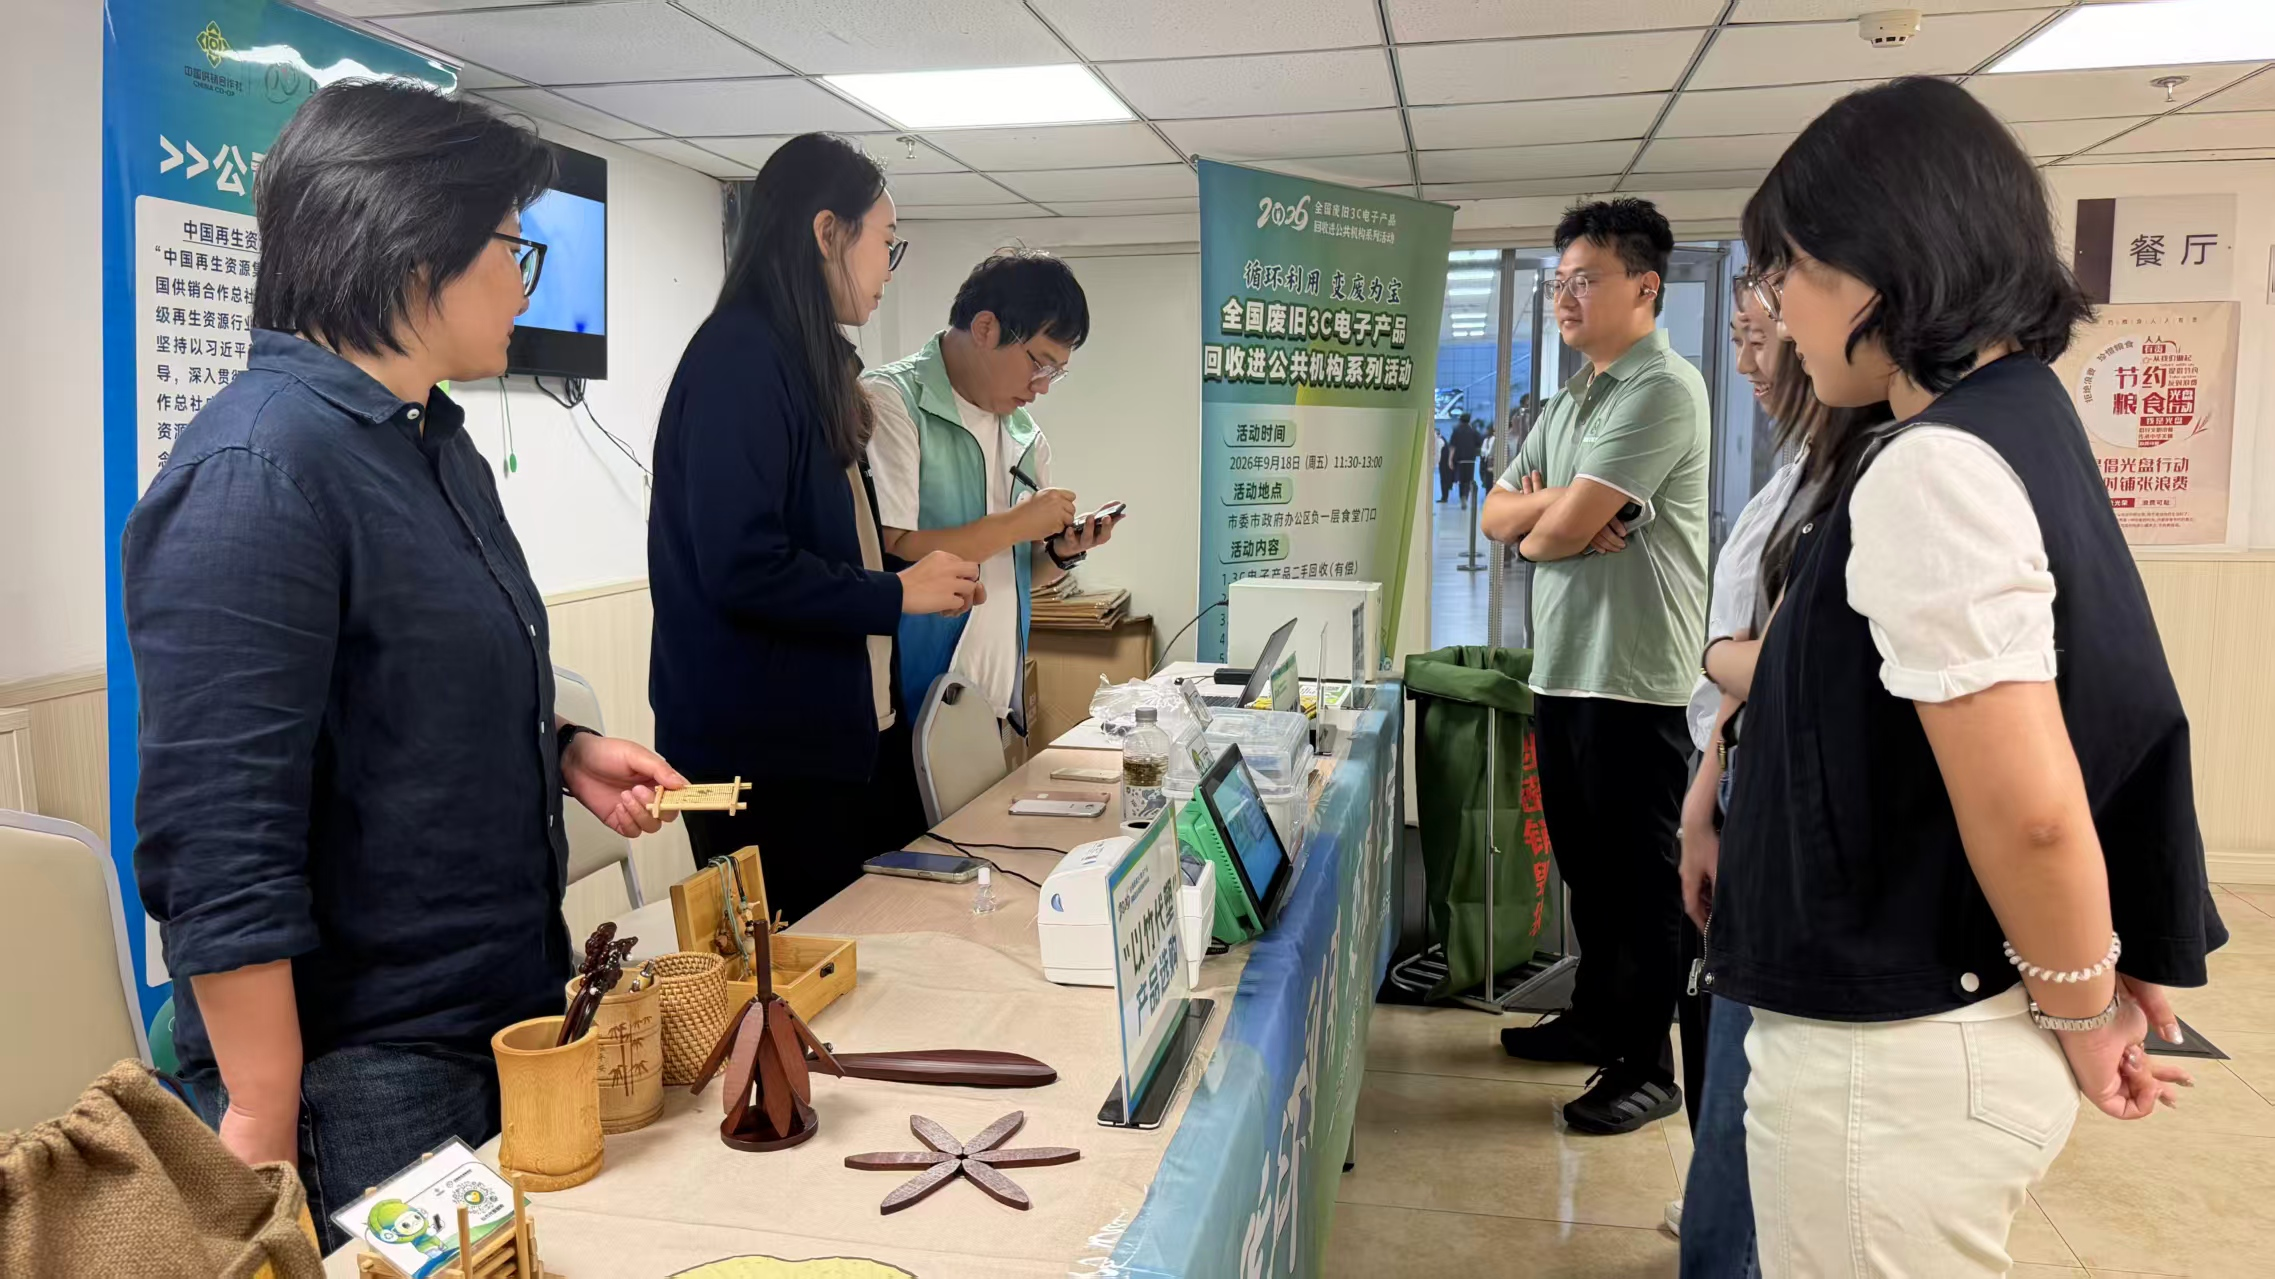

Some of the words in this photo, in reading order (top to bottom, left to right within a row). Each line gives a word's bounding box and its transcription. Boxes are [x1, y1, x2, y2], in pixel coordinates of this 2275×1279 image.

[184, 65, 243, 92] 中国供销合作社
[193, 80, 214, 92] CHINA
[1257, 195, 1310, 231] 2026
[1314, 201, 1397, 226] 全国废旧3C电子产品
[1314, 220, 1395, 245] 回收进公共机构系列活动
[2129, 234, 2218, 267] 餐厅
[1243, 258, 1320, 295] 循环利用
[1330, 269, 1403, 304] 变废为宝
[1221, 297, 1408, 345] 全国废旧3C电子产品
[156, 335, 252, 359] 坚持以习近平
[1203, 344, 1413, 387] 回收进公共机构系列活动
[2114, 366, 2167, 389] 节约
[157, 393, 214, 413] 作总社
[2113, 391, 2167, 415] 粮食
[1236, 424, 1286, 443] 活动时间
[1233, 482, 1283, 501] 活动地点
[1228, 508, 1377, 529] 市委市政府办公区负一层食堂门口
[1230, 538, 1280, 558] 活动内容
